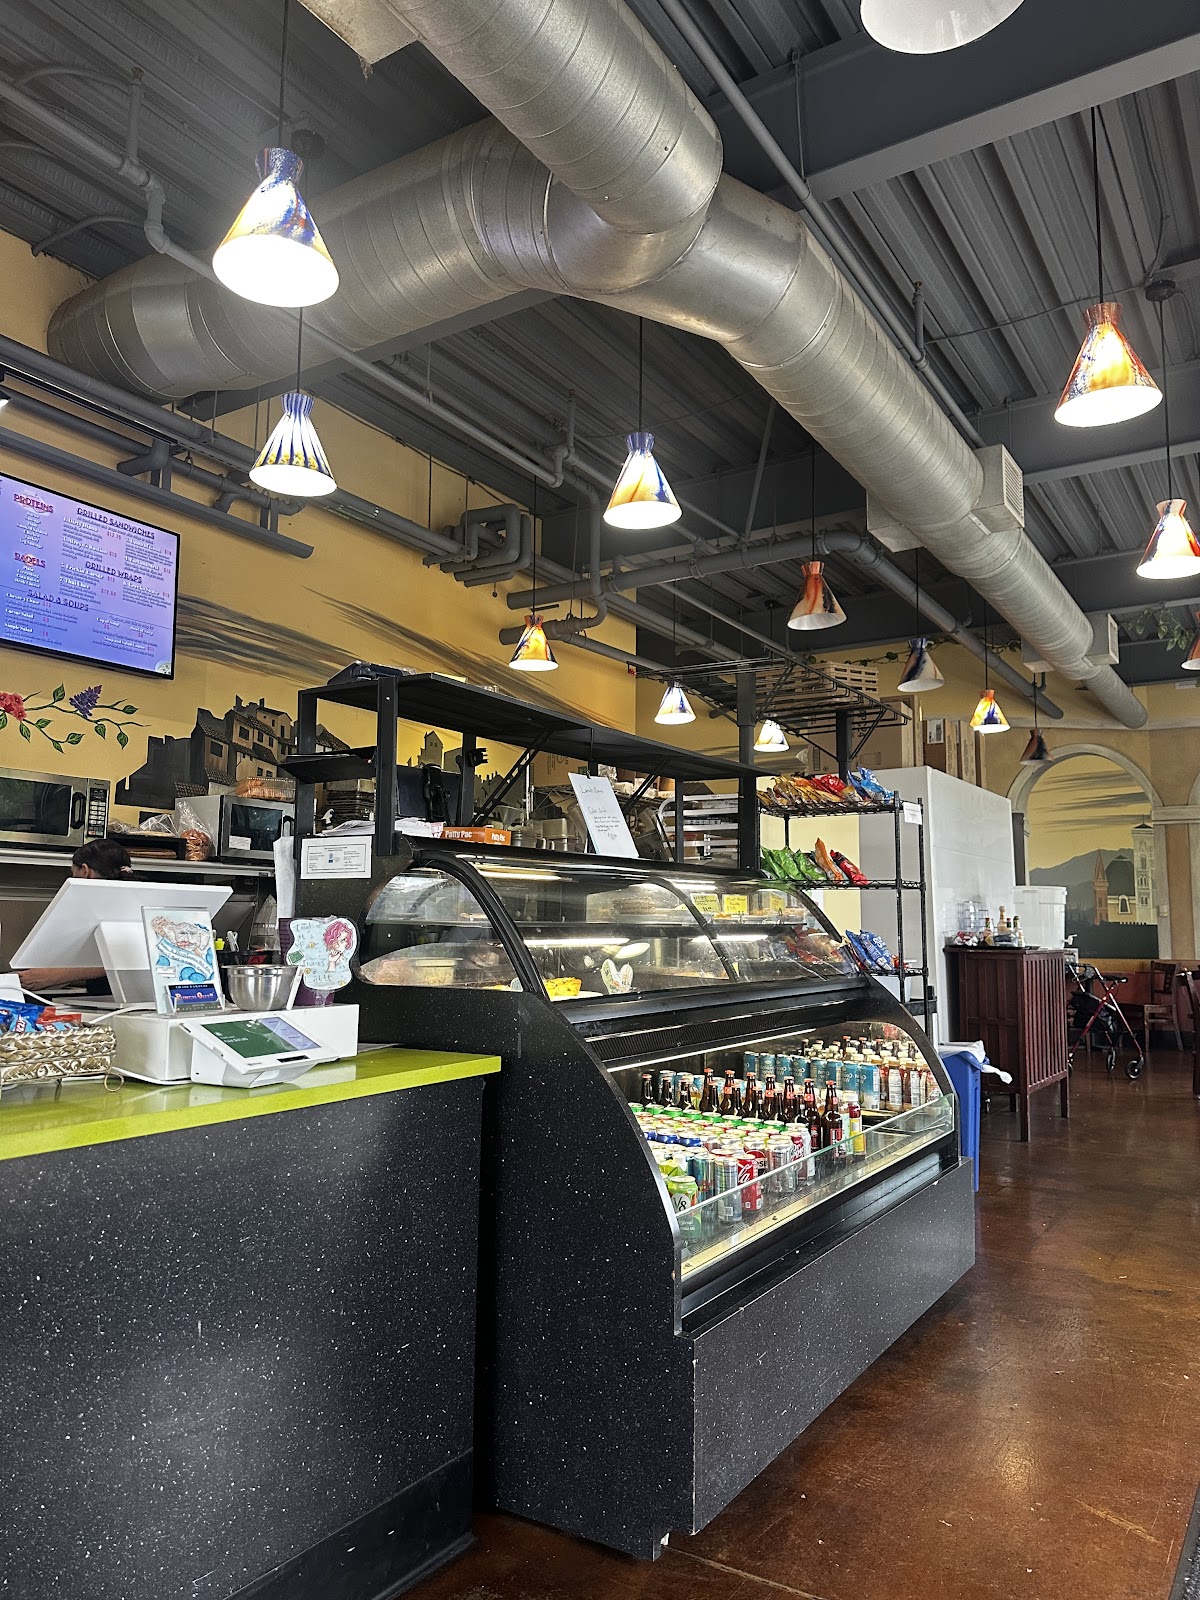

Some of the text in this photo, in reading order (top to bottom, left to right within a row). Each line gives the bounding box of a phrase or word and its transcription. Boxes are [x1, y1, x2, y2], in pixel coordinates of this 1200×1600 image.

[13, 493, 53, 514] PROTEINS
[76, 506, 107, 524] GRILLED
[109, 518, 154, 540] SANDWICHES
[14, 551, 45, 568] BAGELS
[85, 560, 115, 575] GRILLED
[117, 570, 142, 584] WRAPS
[27, 588, 54, 602] SALAD
[63, 598, 89, 611] SOUPS
[445, 830, 461, 839] Patty
[673, 1196, 687, 1212] V8
